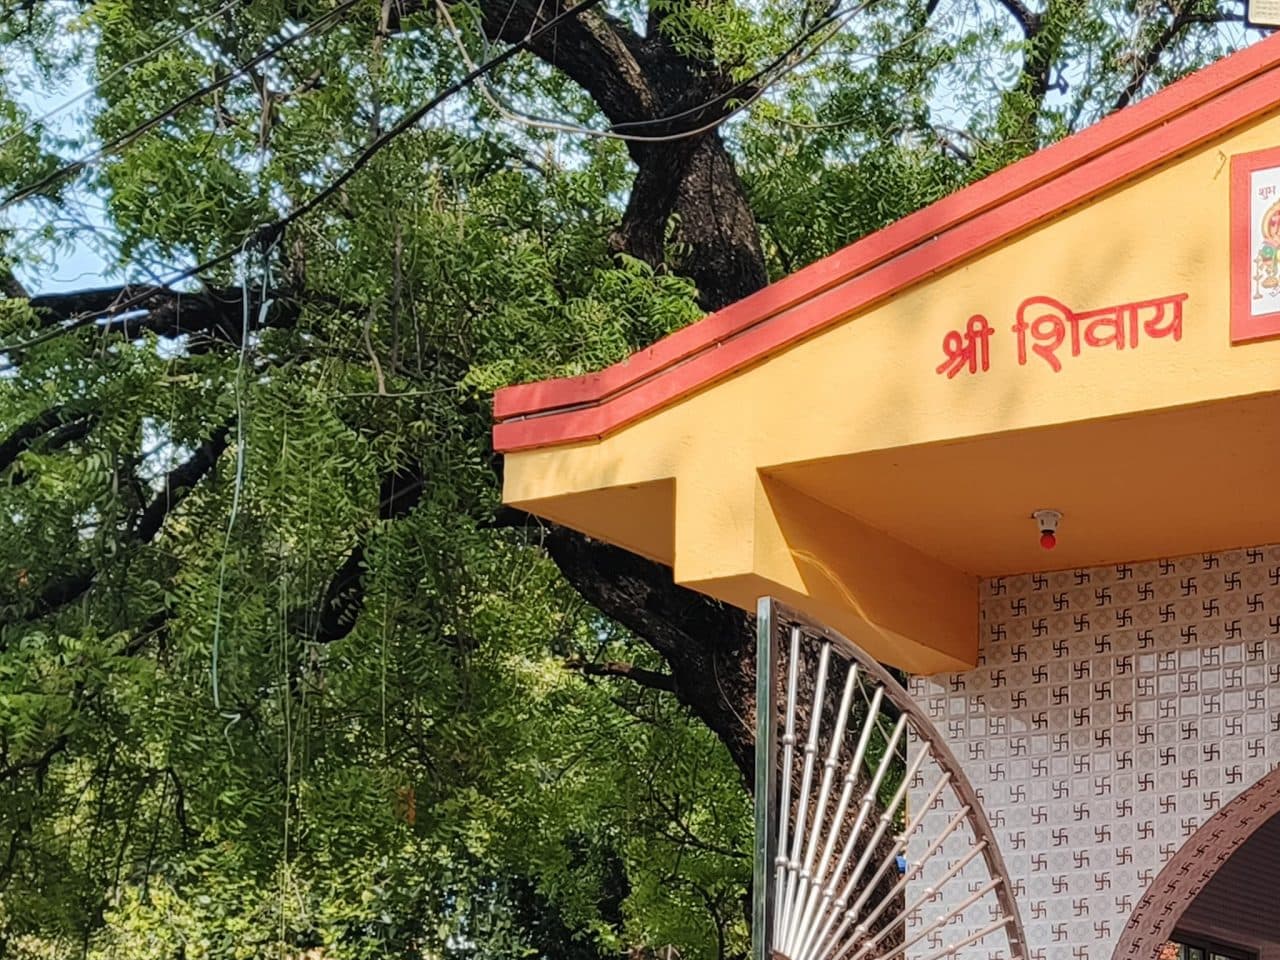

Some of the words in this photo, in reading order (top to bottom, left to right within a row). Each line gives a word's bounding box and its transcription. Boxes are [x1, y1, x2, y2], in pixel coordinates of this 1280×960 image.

[1258, 185, 1276, 200] शुभ
[936, 314, 995, 378] श्री
[1012, 293, 1188, 373] शिवाय
